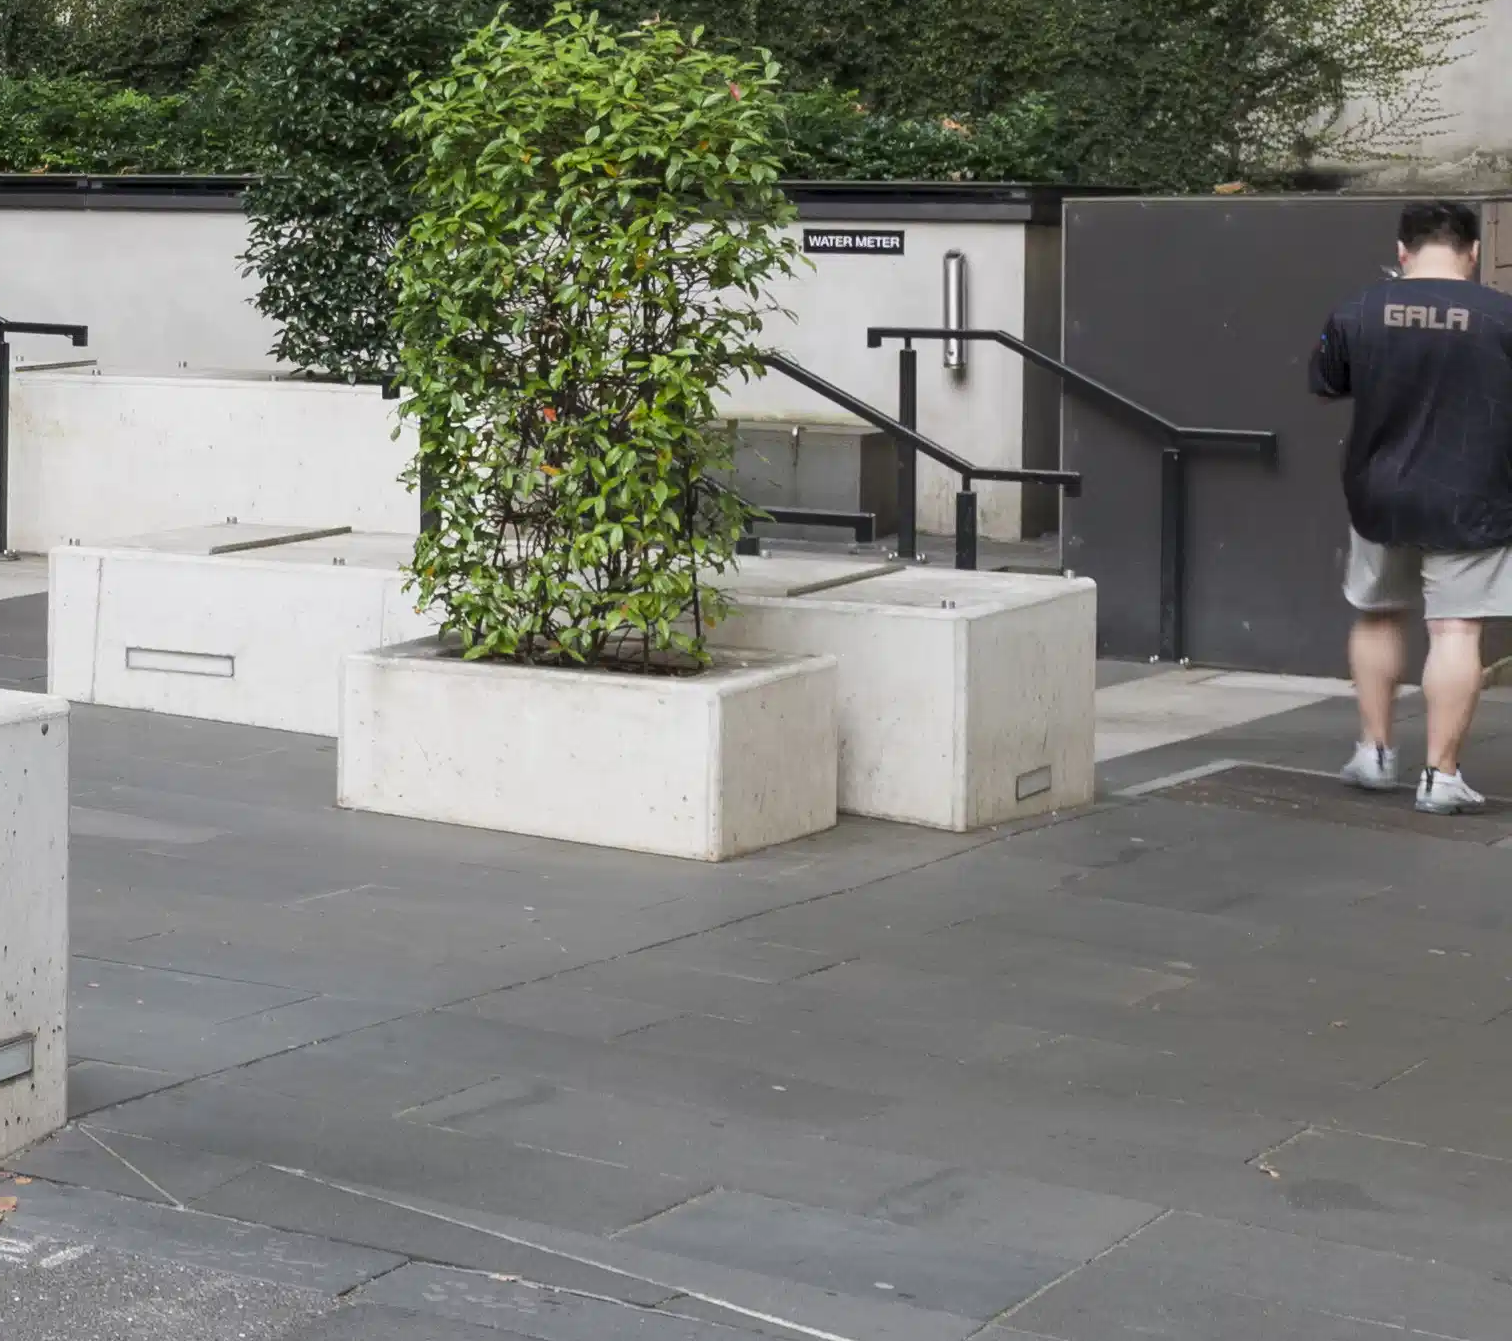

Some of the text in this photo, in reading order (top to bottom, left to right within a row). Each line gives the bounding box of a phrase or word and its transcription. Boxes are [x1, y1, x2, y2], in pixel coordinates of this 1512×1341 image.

[809, 235, 900, 248] WATER METER
[1384, 304, 1469, 332] GALA
